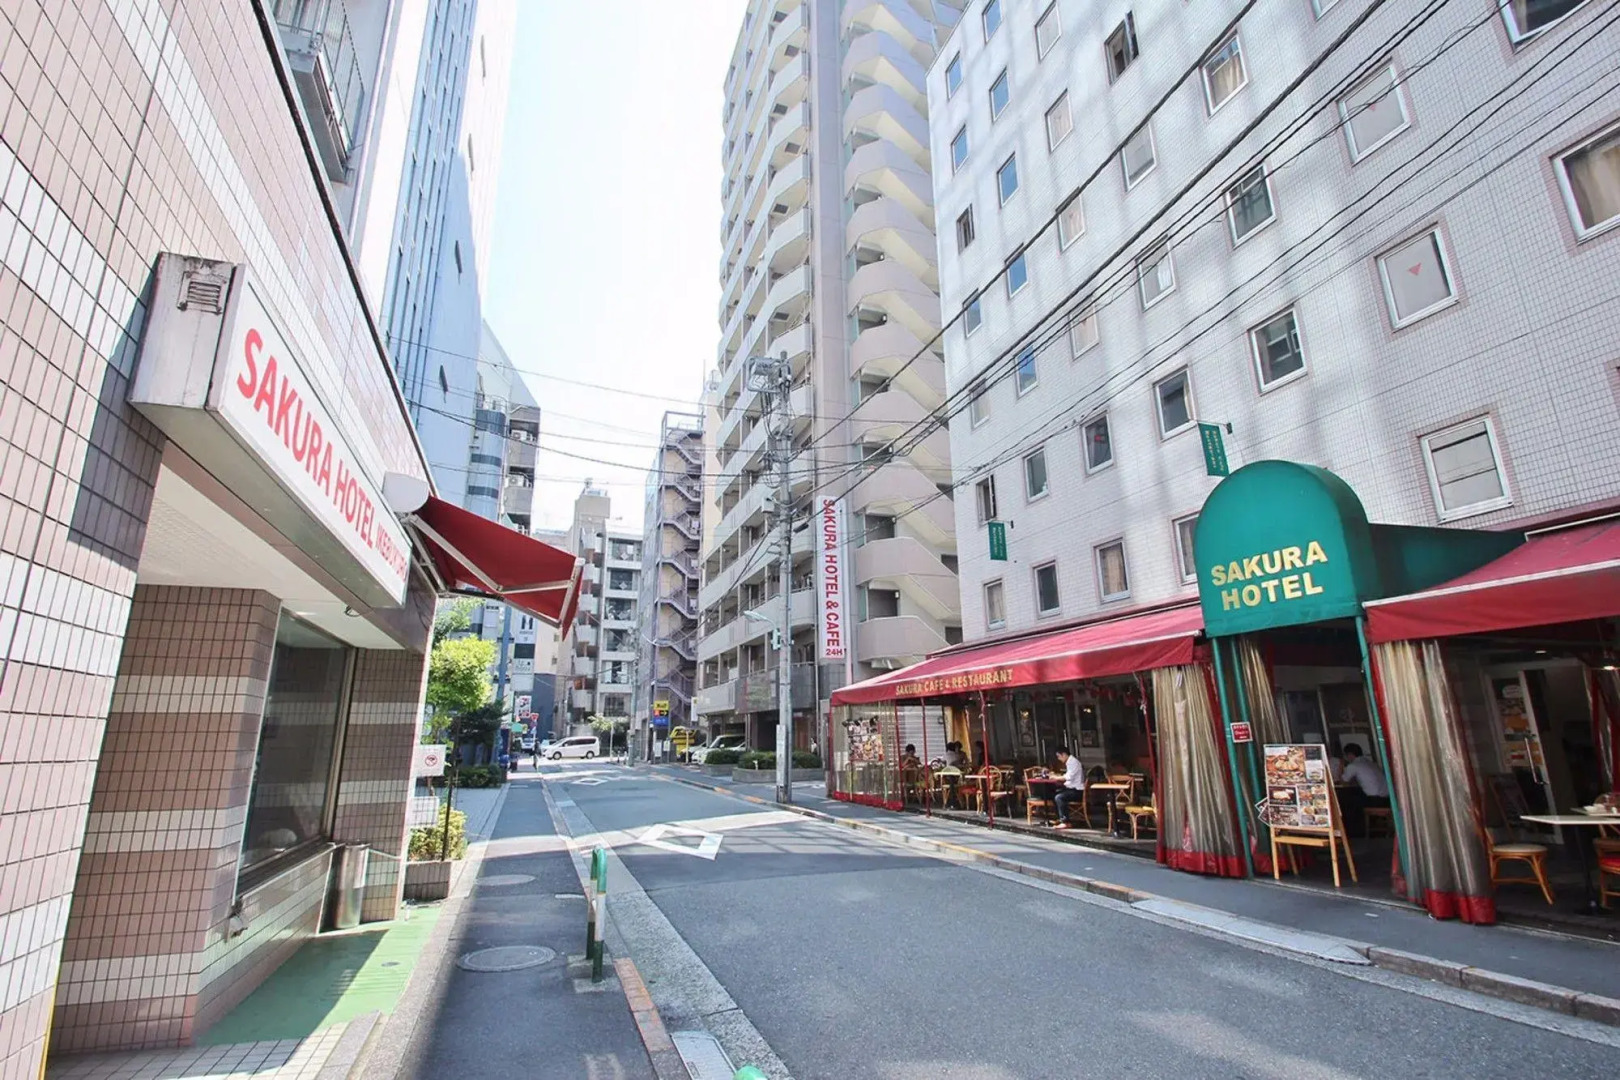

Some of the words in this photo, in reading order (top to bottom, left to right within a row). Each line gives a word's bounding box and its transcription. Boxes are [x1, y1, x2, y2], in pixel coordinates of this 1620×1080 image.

[237, 328, 333, 497] SAKURA
[333, 459, 375, 548] HOTEL
[823, 499, 837, 550] SAKURA
[825, 555, 838, 598] HOTEL
[1211, 540, 1328, 586] SAKURA
[826, 600, 839, 609] &
[1221, 572, 1324, 611] HOTEL
[826, 612, 840, 647] CAFE
[826, 648, 843, 656] 24H
[896, 683, 922, 696] SAKURA
[924, 679, 943, 692] CAFE
[951, 669, 1013, 689] RESTAURANT
